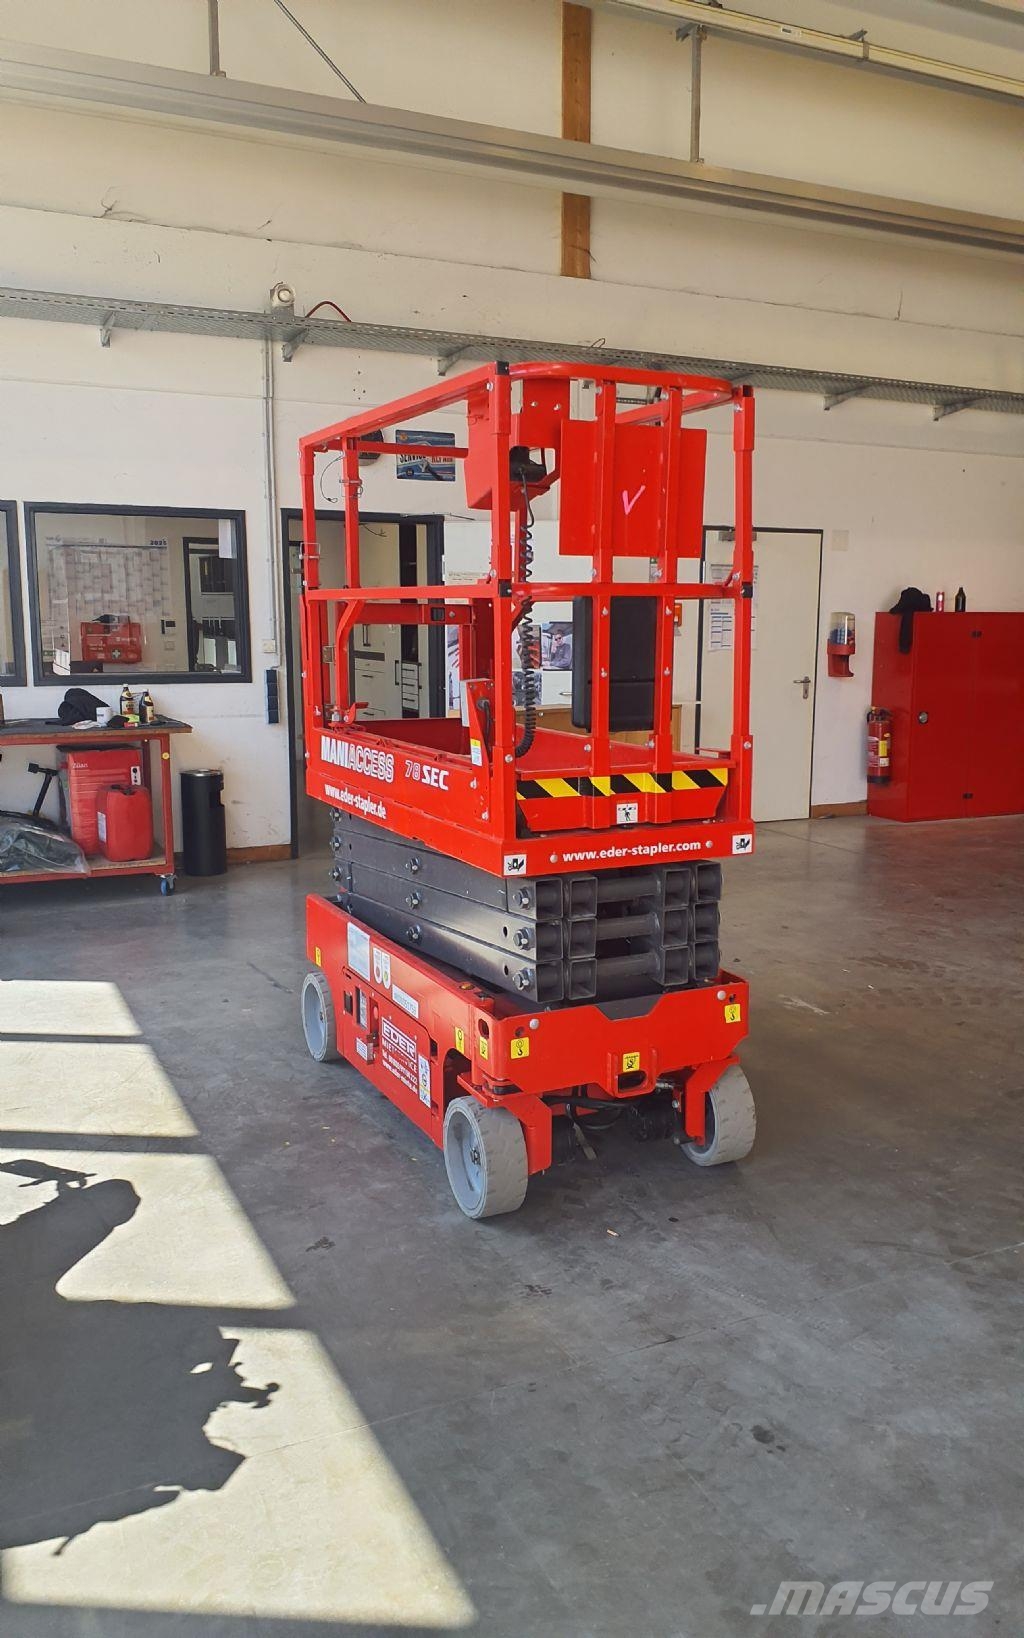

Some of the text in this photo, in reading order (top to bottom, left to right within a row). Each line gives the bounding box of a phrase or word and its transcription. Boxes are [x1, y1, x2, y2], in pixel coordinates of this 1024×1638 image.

[324, 783, 387, 820] www.eder-stapler.de
[562, 841, 702, 863] www.eder-stapler.com
[383, 1021, 415, 1059] EDER
